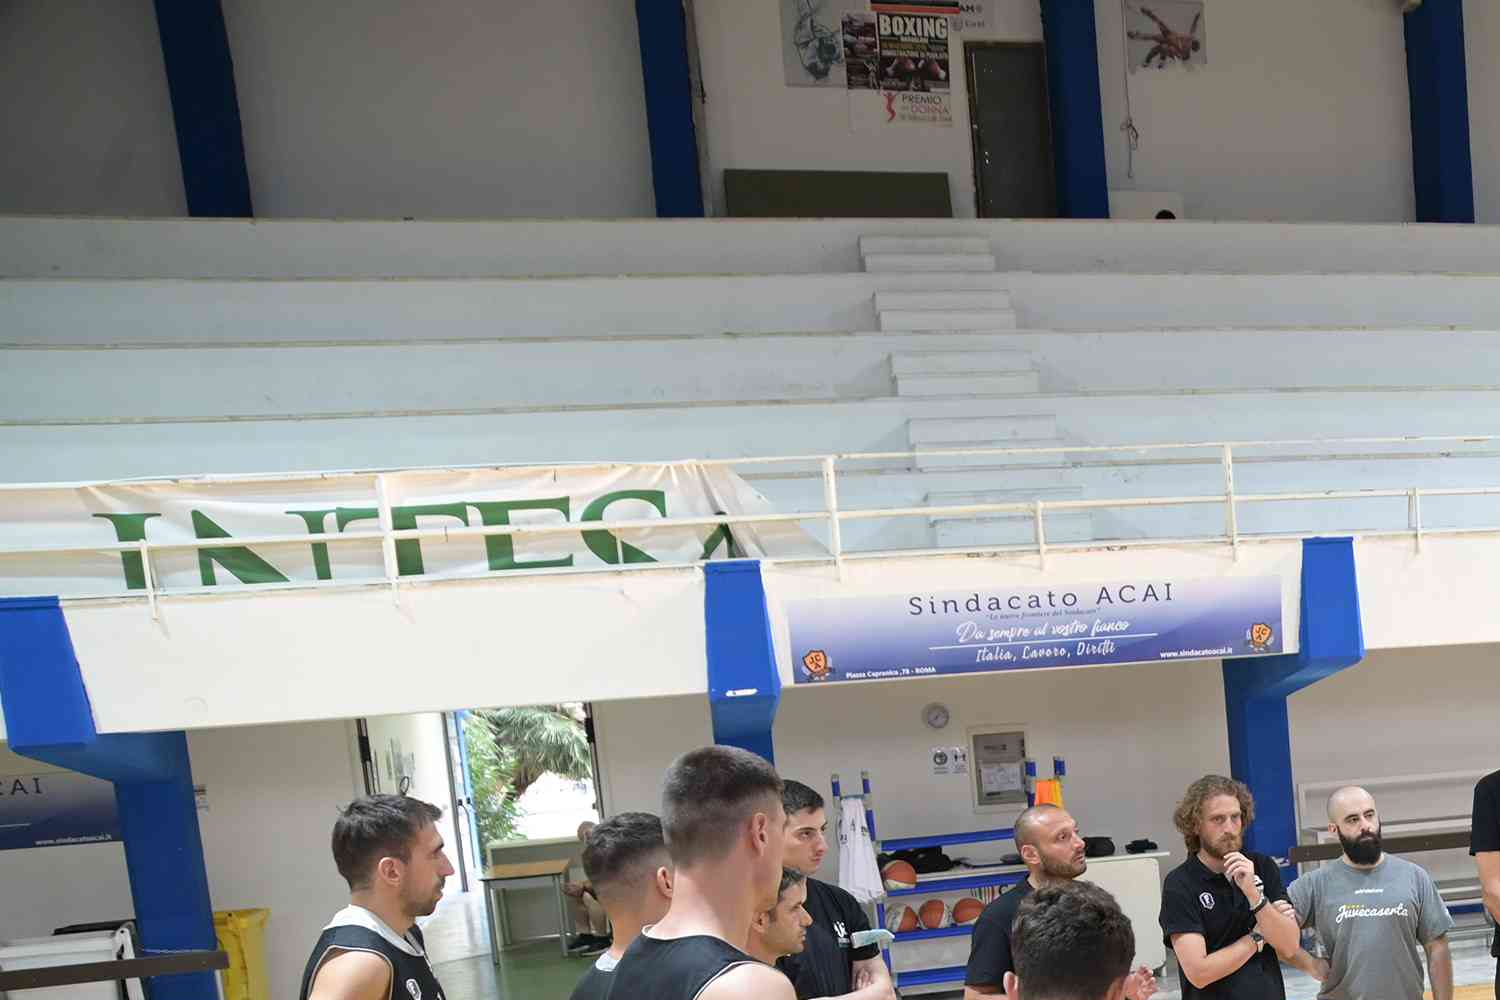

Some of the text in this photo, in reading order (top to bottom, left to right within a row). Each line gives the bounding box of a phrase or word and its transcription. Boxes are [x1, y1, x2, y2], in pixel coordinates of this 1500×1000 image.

[880, 14, 947, 39] BOXING
[902, 94, 942, 105] PREMIO
[909, 583, 1173, 615] Sindacato ACAI
[956, 621, 984, 643] Da
[986, 626, 1031, 642] sempre
[1052, 620, 1088, 637] vostro
[976, 648, 1017, 662] Italia,
[1336, 902, 1409, 923] Juvecaserta
